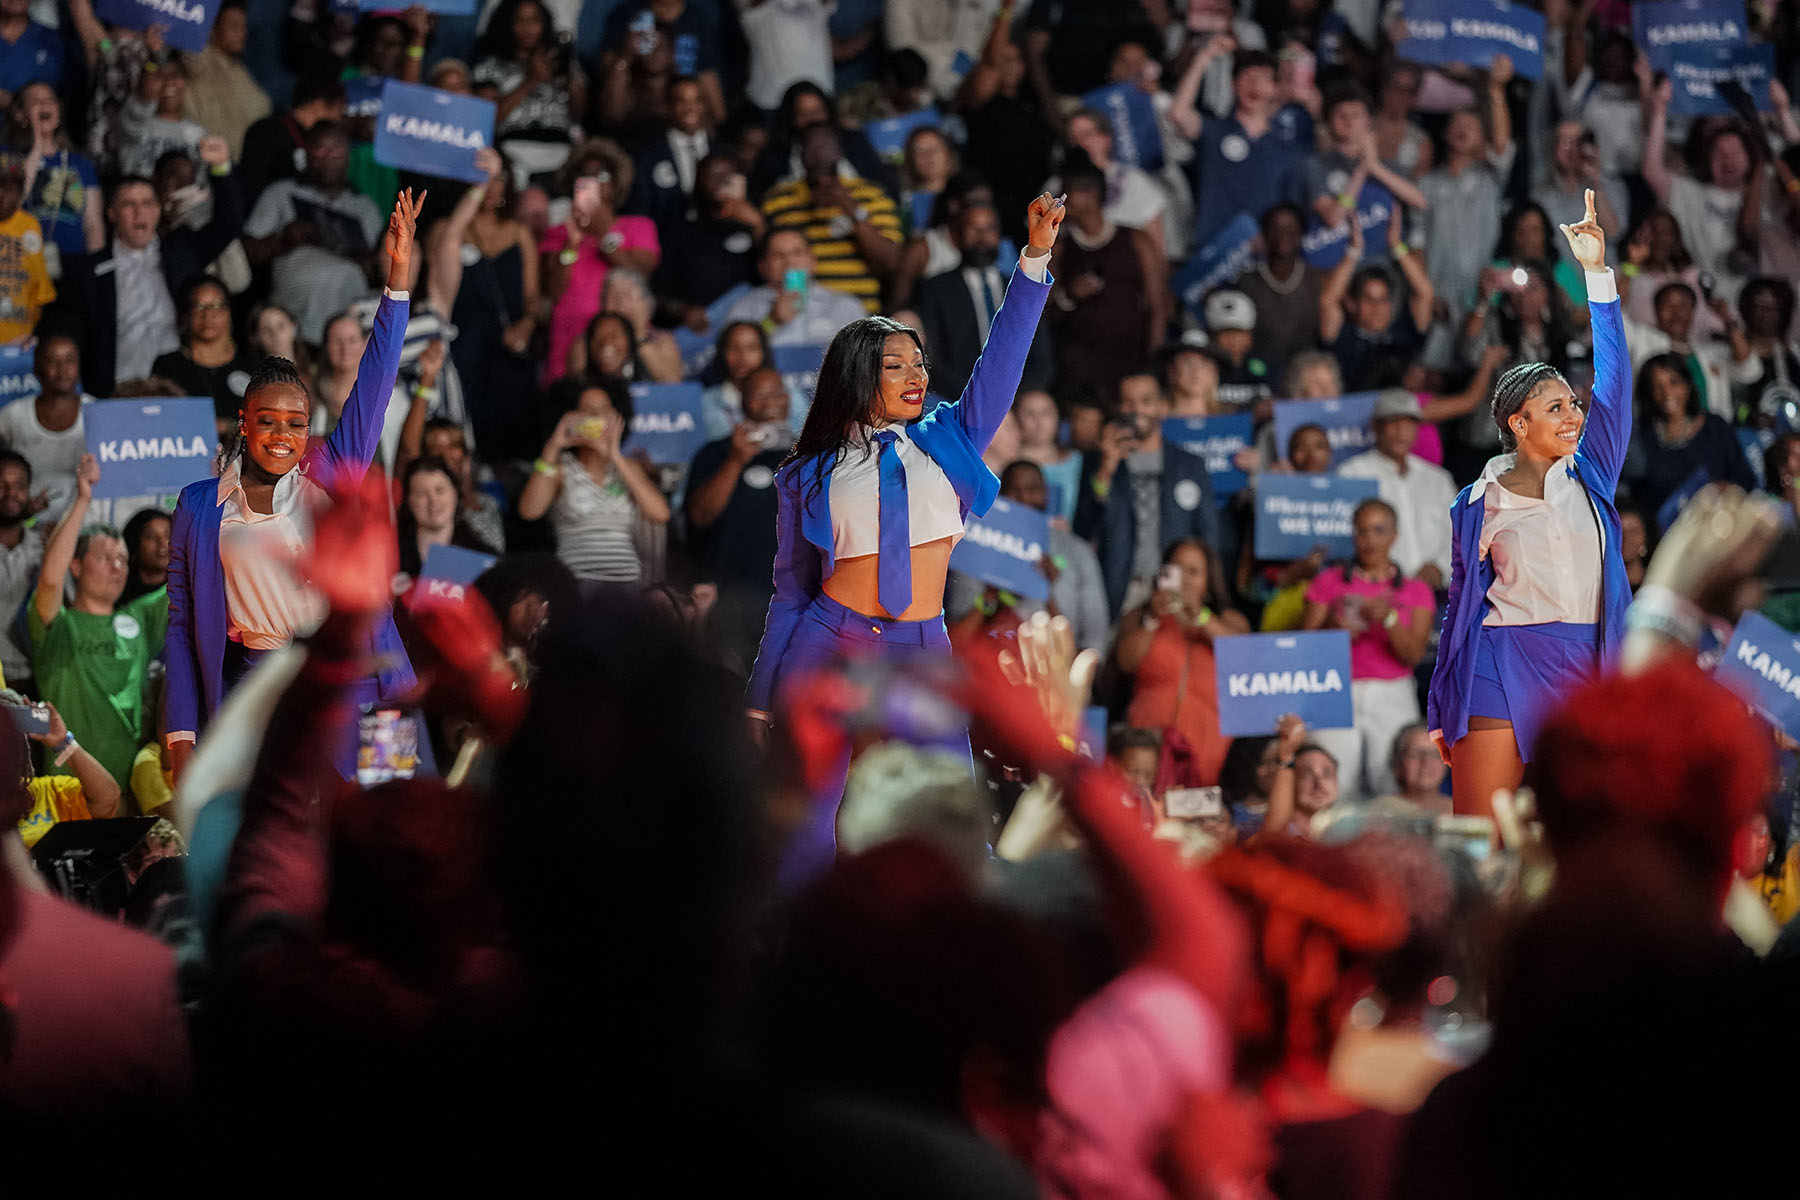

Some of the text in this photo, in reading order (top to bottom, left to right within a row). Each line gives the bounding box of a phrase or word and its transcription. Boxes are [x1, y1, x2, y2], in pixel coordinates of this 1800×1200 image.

[1648, 20, 1740, 46] KAMALA
[386, 113, 485, 151] KAMALA
[99, 435, 209, 463] KAMALA
[1278, 518, 1311, 535] WE
[1228, 669, 1343, 697] KAMALA
